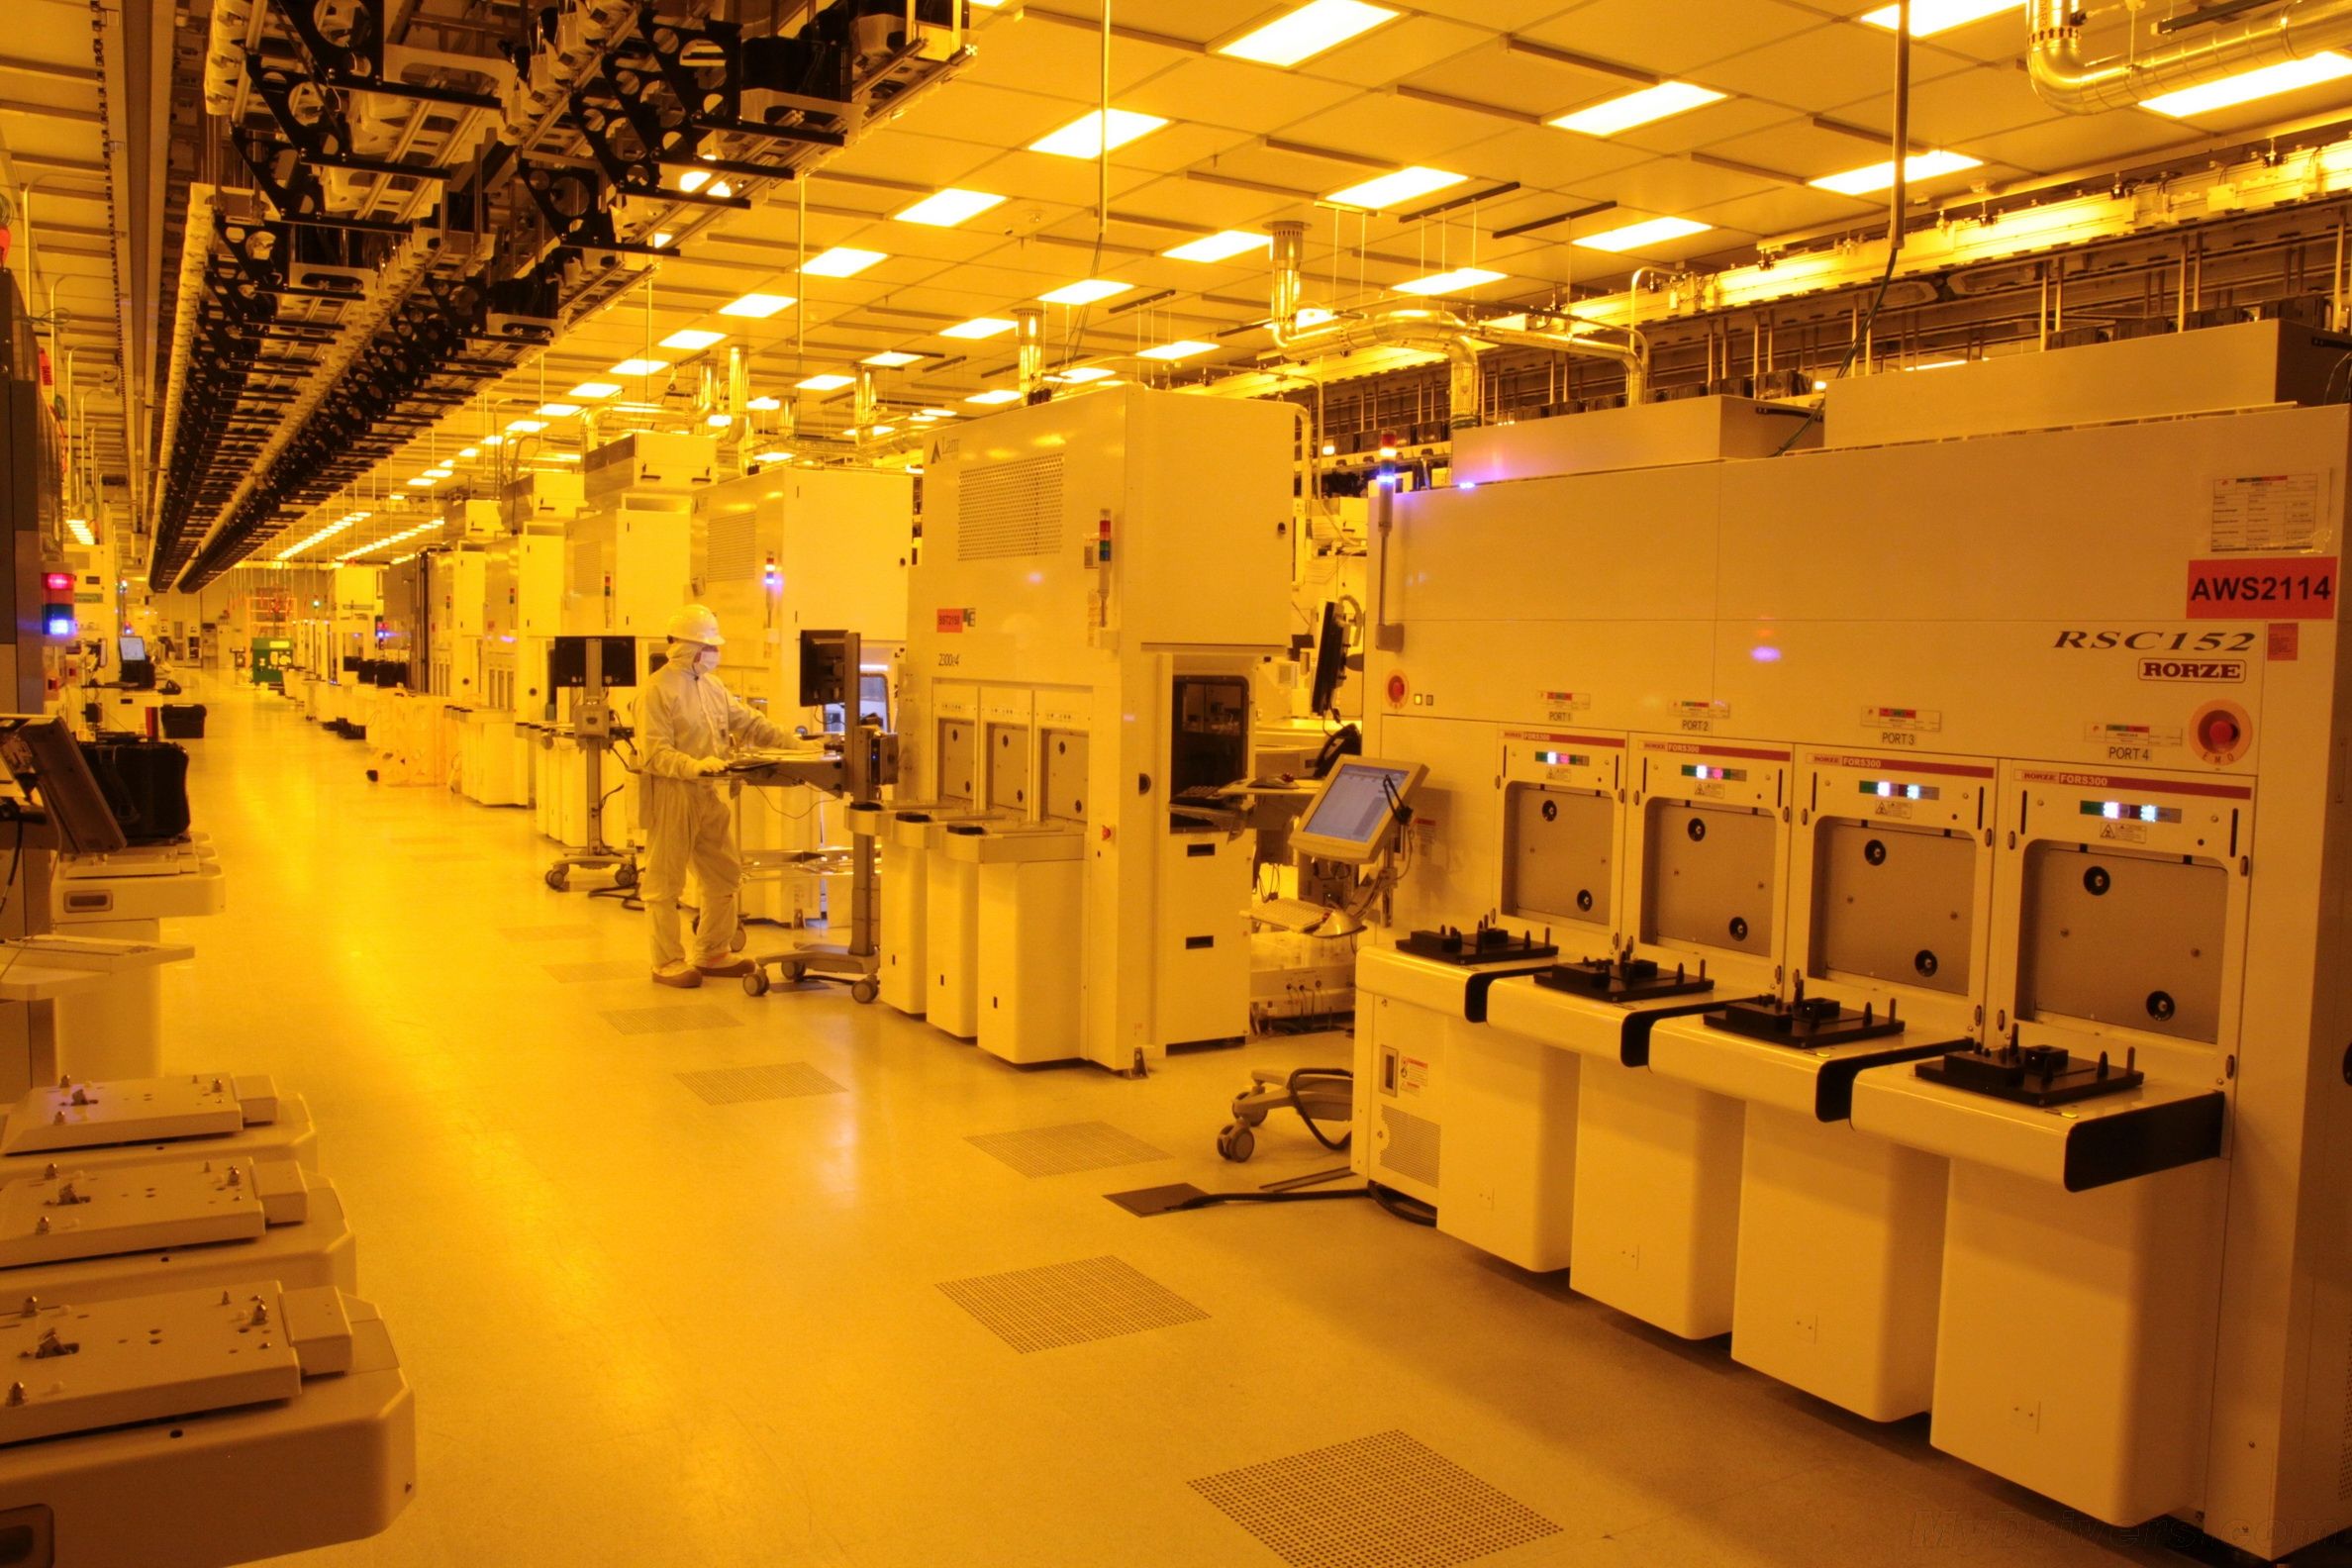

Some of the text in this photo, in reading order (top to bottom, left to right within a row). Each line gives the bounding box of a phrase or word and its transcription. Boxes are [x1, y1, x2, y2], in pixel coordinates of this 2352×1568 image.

[2190, 576, 2331, 601] AWS2114
[2053, 631, 2256, 651] RSC152
[2143, 662, 2240, 679] RORZE
[1549, 712, 1567, 722] PORT
[1682, 720, 1703, 731] PORT
[1882, 733, 1914, 745] PORT 3
[2108, 746, 2149, 760] PORT 4
[1843, 757, 1881, 768] FORS300
[2060, 774, 2107, 786] FORS300
